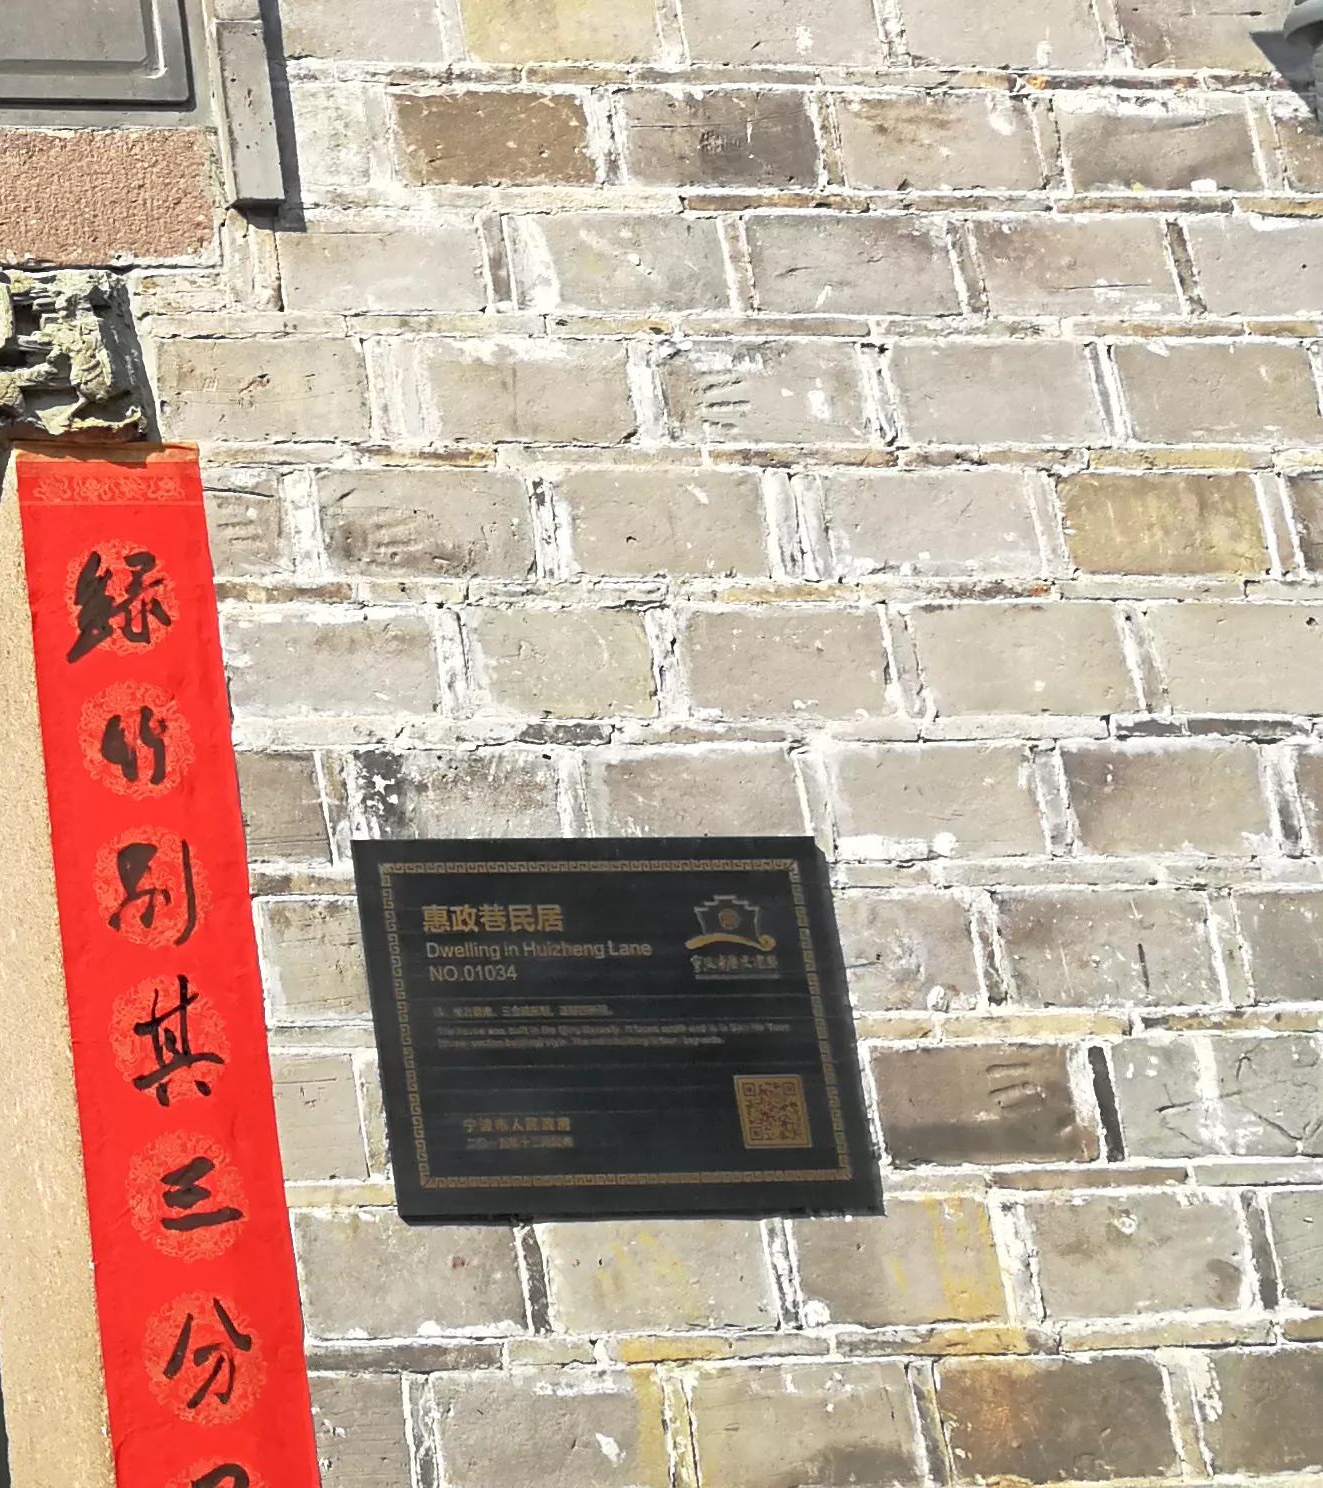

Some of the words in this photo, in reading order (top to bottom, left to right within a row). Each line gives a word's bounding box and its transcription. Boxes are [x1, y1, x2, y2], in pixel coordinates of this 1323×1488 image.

[421, 903, 564, 934] 惠政巷民居
[426, 942, 501, 960] Dwelling
[504, 942, 520, 957] in
[523, 940, 606, 959] Huizheng
[607, 940, 653, 957] Lane
[429, 964, 519, 983] NO.01034
